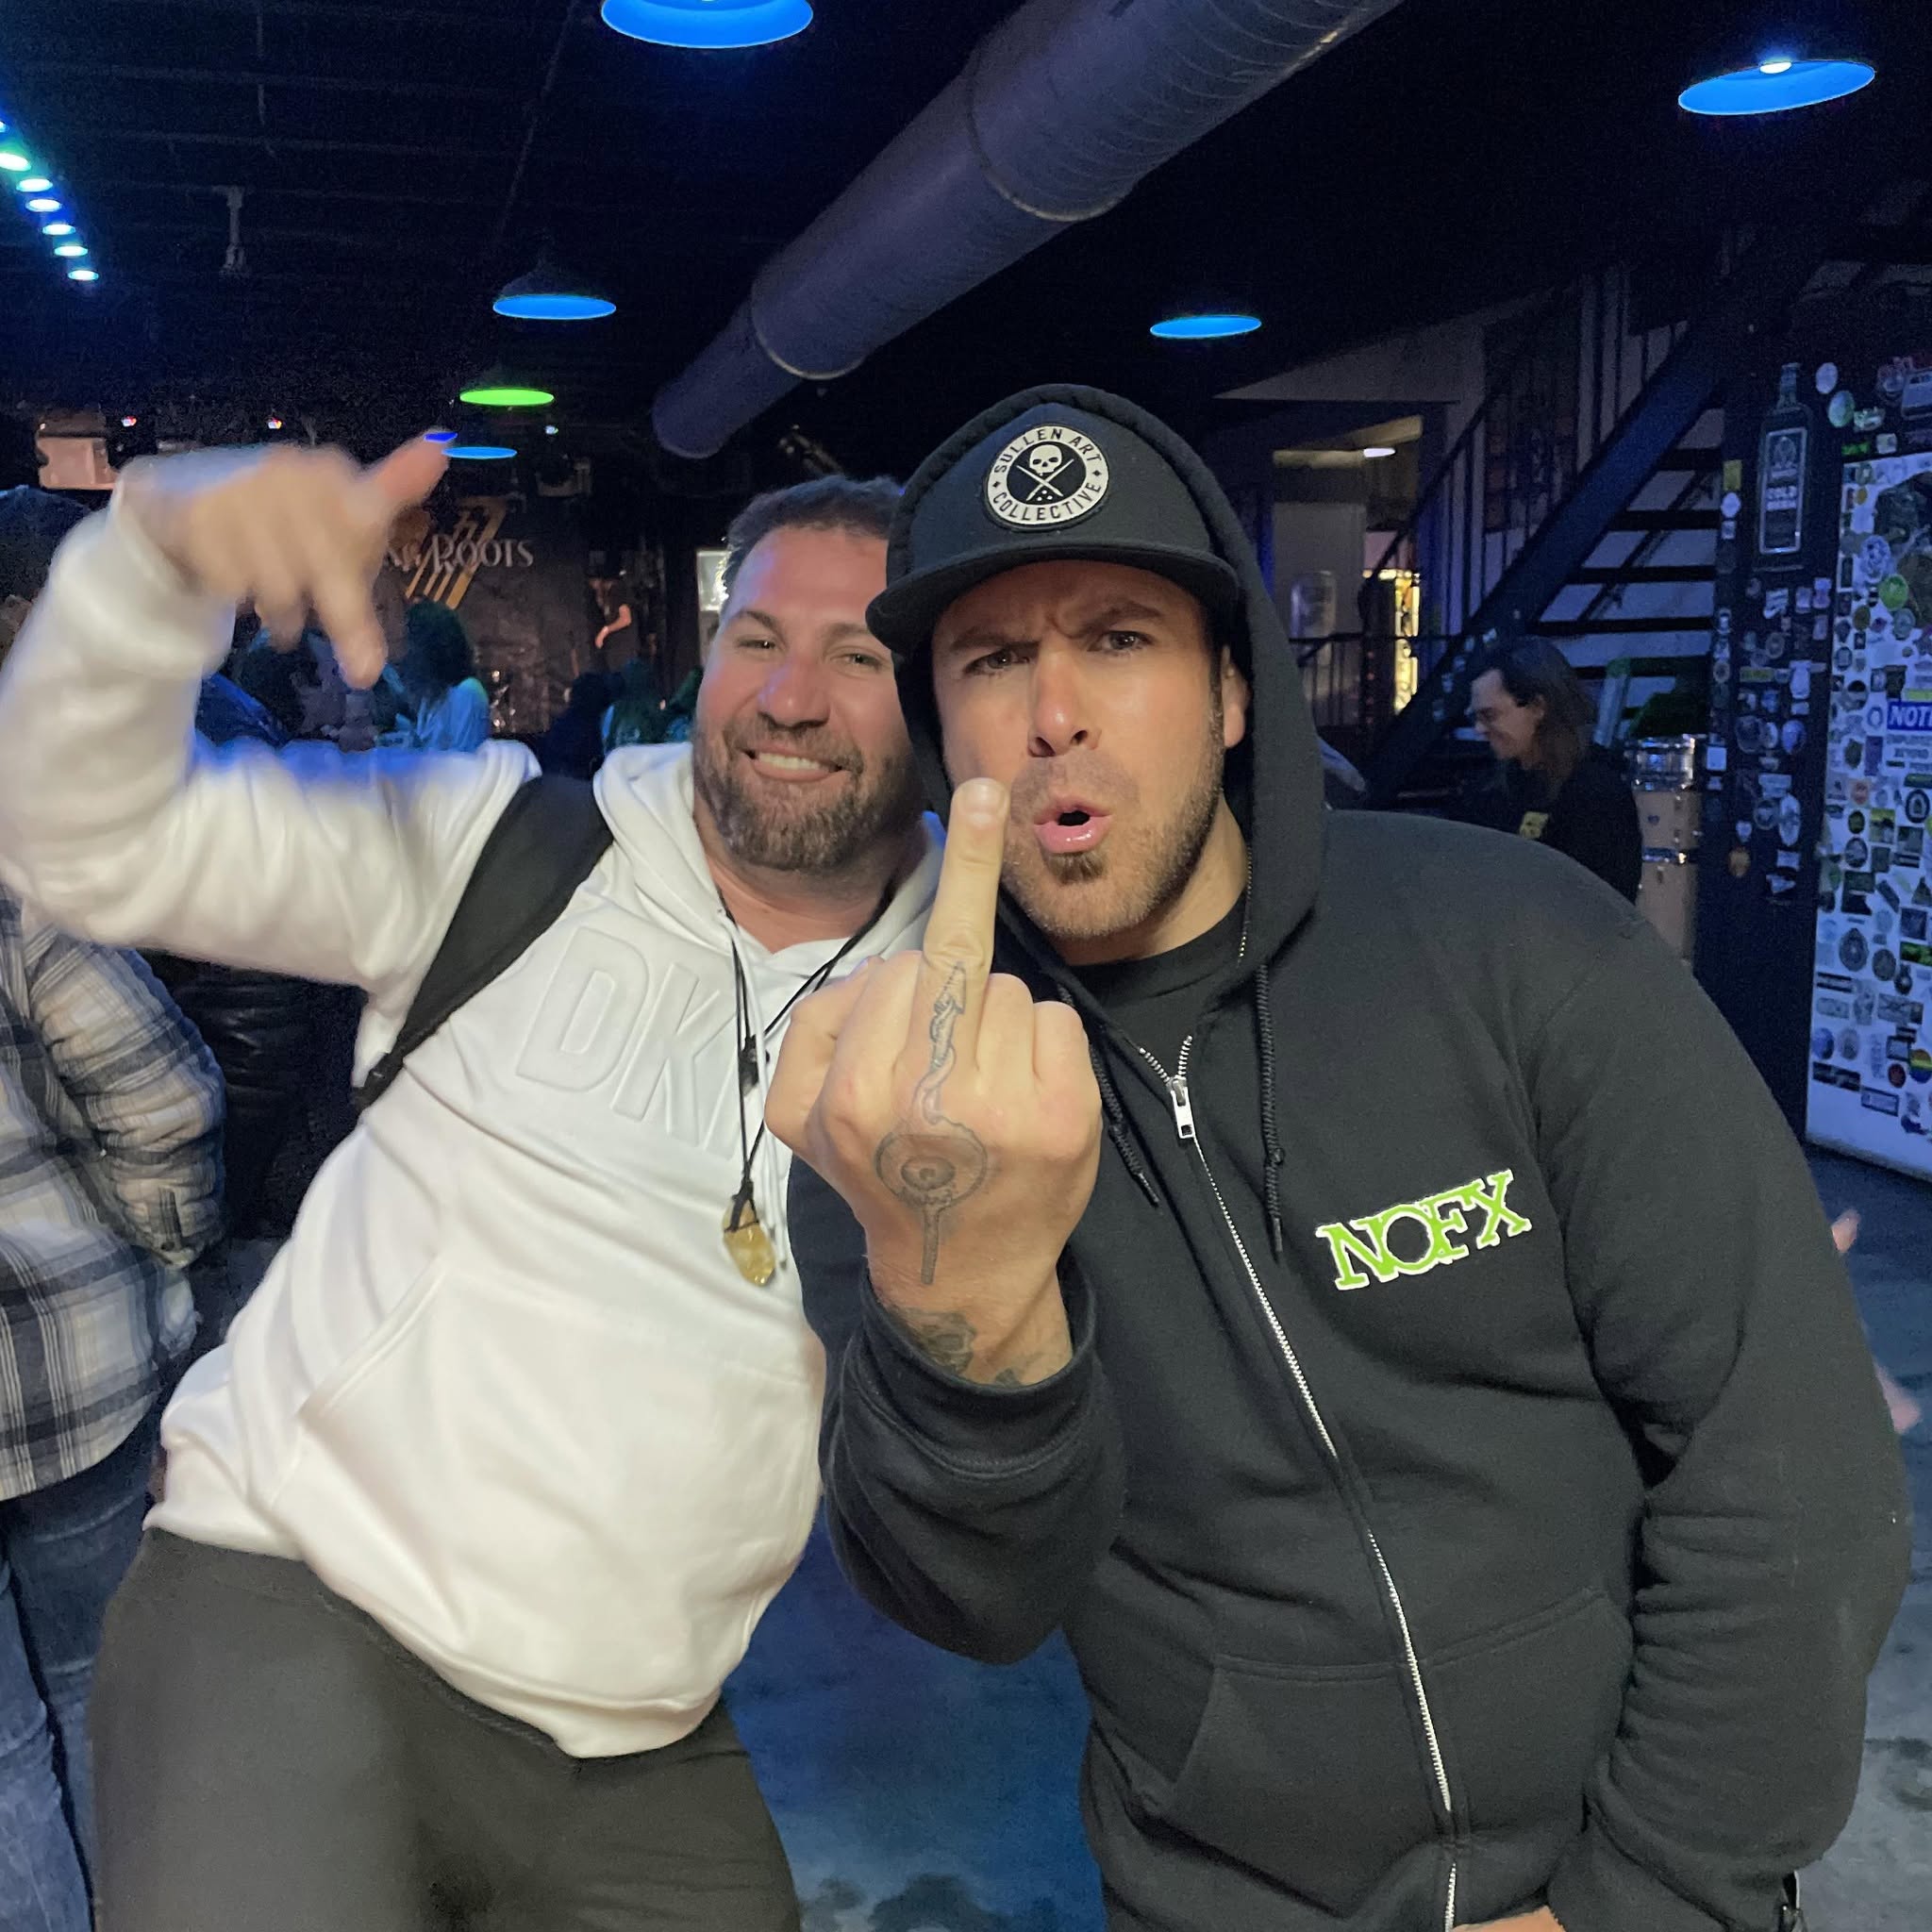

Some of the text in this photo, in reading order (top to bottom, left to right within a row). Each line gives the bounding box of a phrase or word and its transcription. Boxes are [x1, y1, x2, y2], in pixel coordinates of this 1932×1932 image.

[993, 427, 1103, 474] SULLEN ART
[992, 482, 1102, 521] COLLECTIVE
[1315, 1169, 1533, 1291] NOFX
